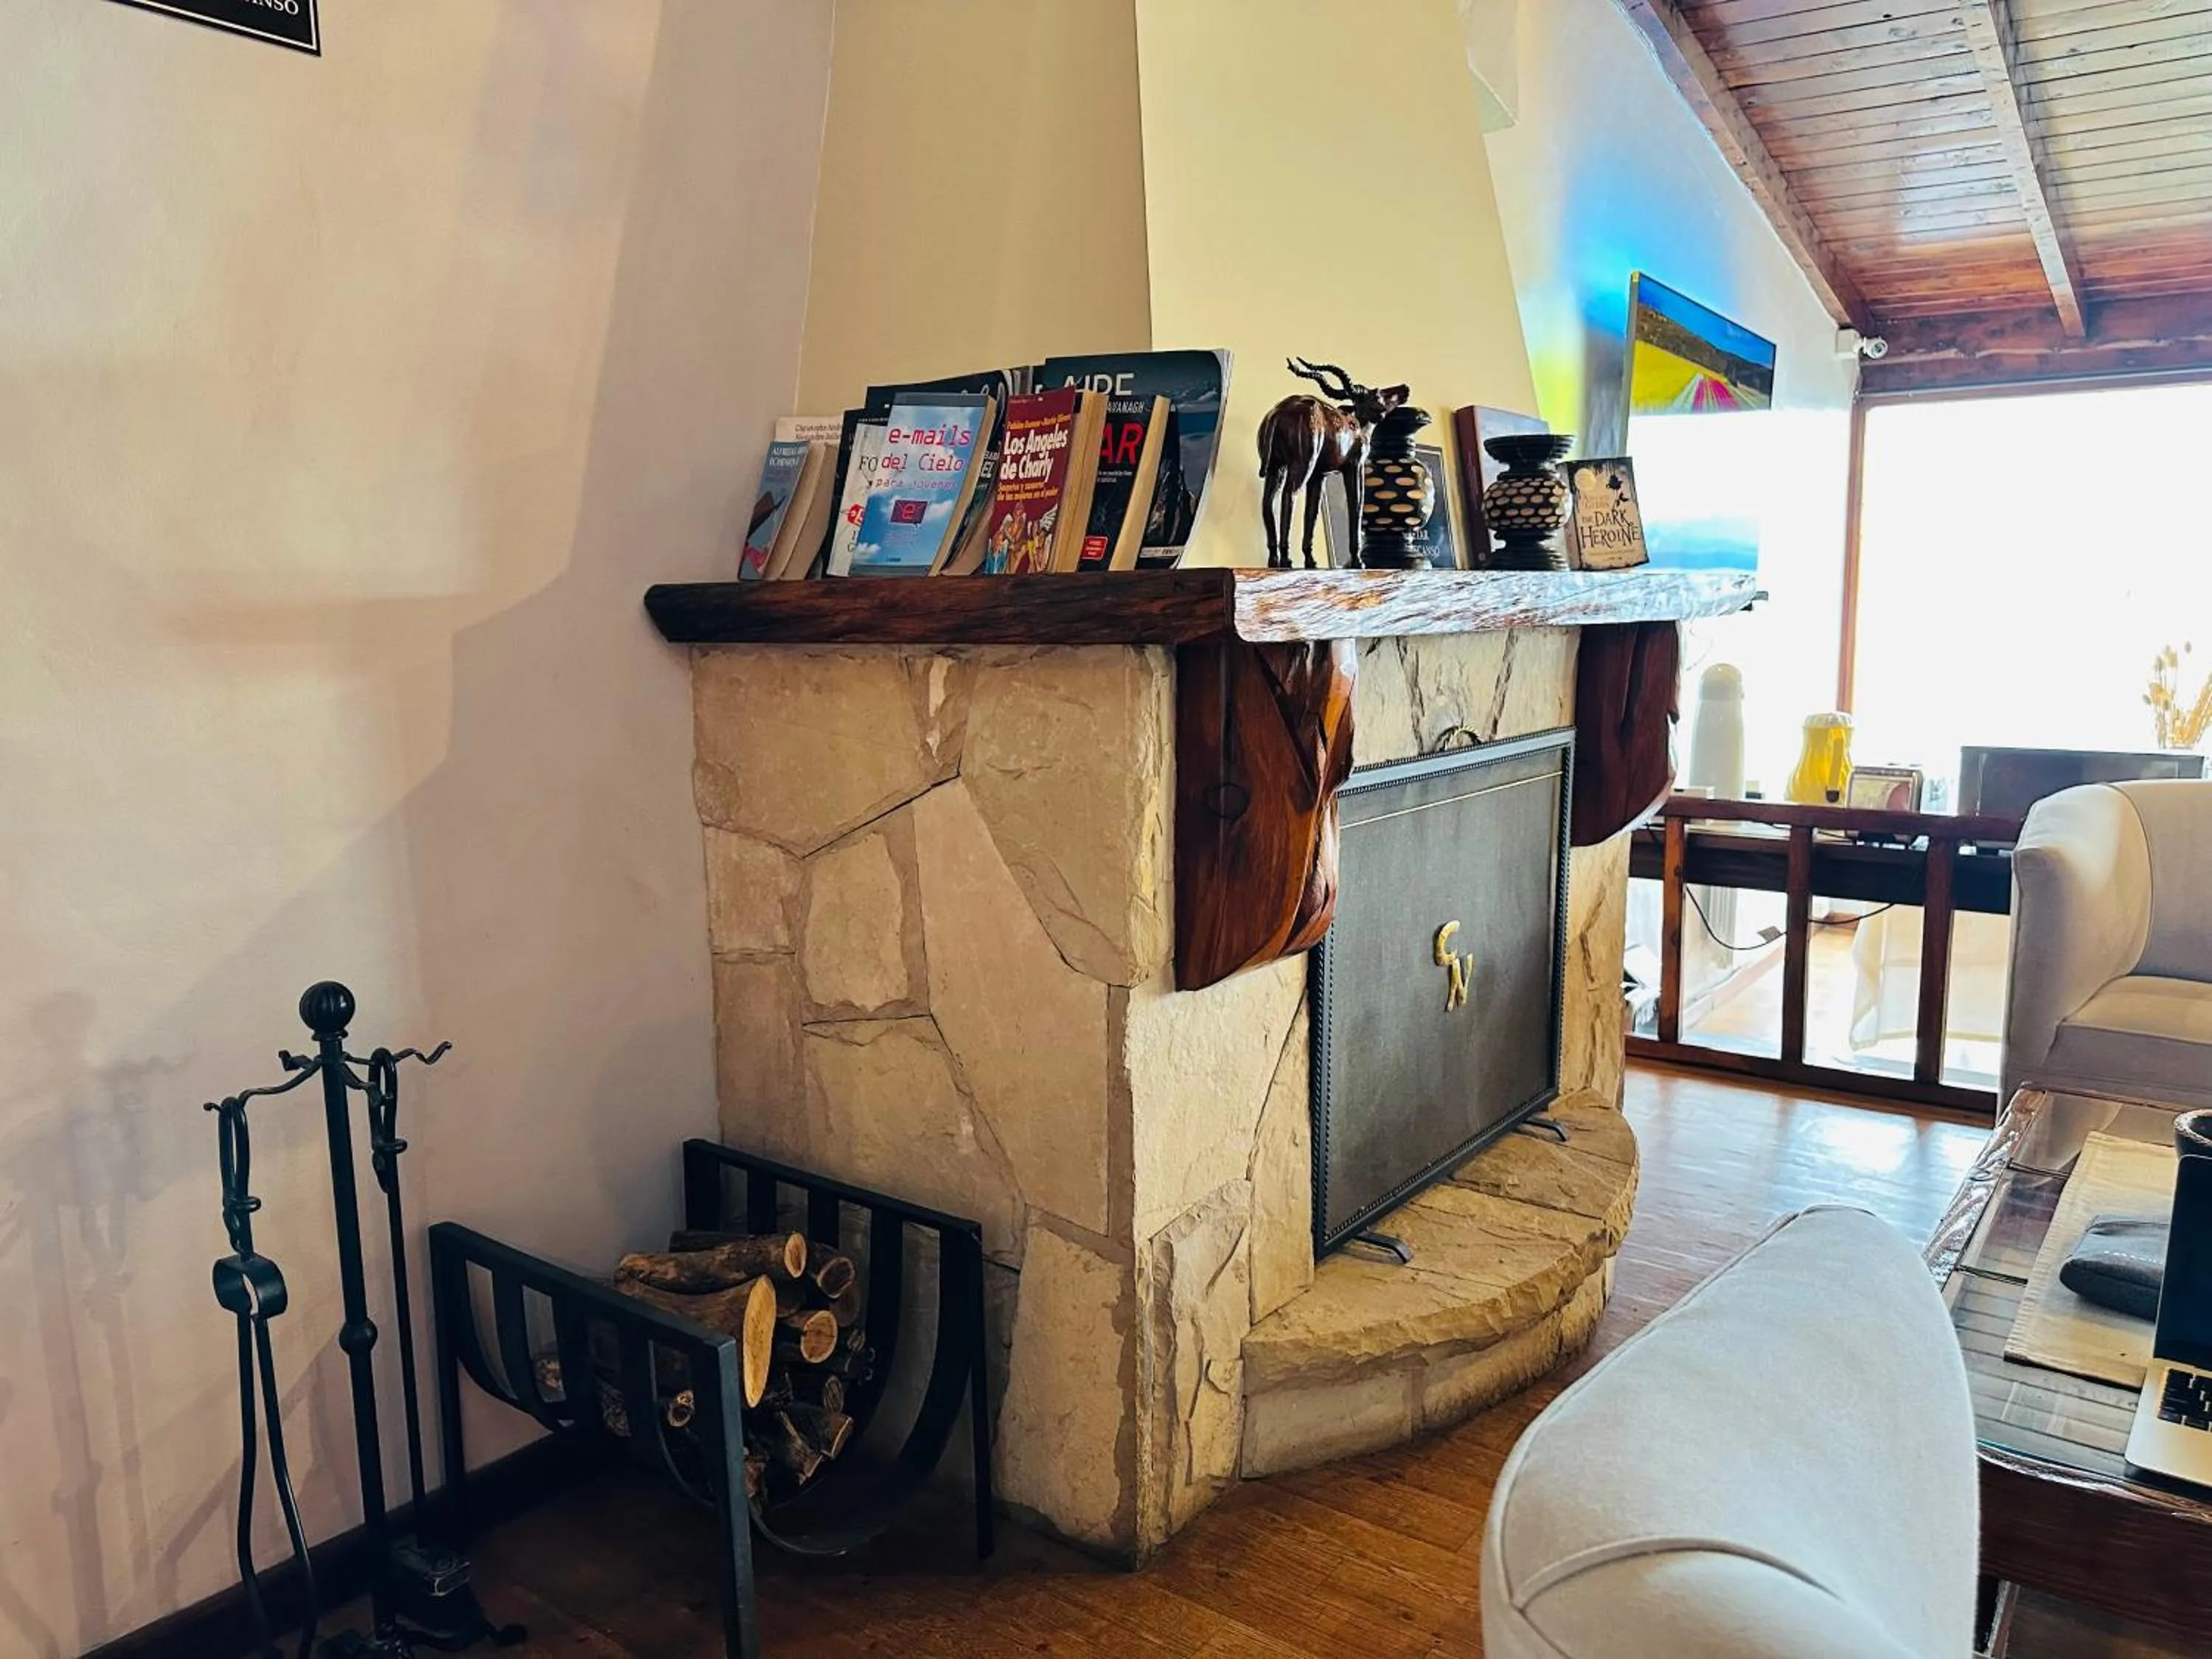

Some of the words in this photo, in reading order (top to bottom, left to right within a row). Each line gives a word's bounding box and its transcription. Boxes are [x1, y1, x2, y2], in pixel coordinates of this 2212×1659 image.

[888, 425, 972, 446] e-mails
[1004, 431, 1026, 454] Los
[1025, 422, 1068, 459] Angeles
[882, 453, 908, 470] del
[918, 453, 963, 471] Cielo
[1000, 455, 1017, 479] de
[1018, 451, 1053, 483] Charly
[1594, 509, 1634, 527] DARK
[1580, 526, 1641, 549] HEROINE
